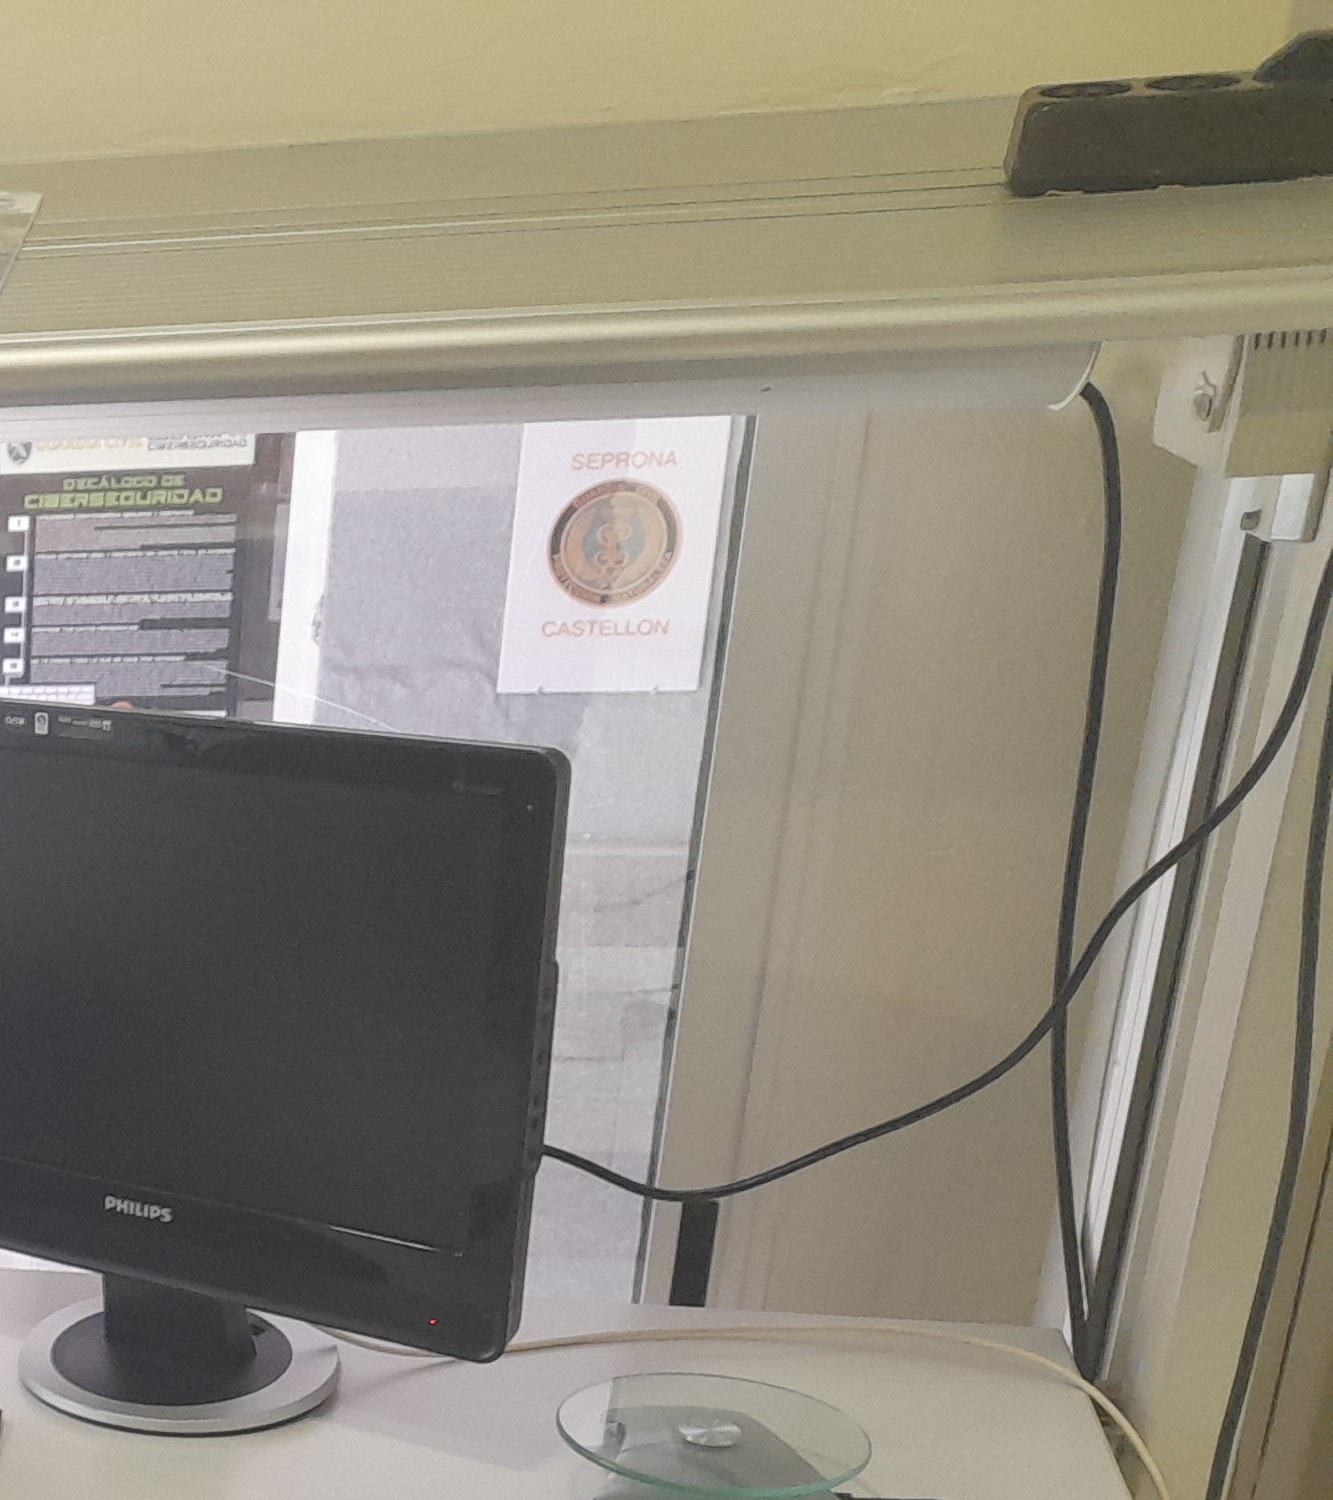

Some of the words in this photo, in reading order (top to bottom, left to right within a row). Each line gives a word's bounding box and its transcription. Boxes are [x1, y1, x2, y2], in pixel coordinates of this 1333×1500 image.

[571, 451, 678, 471] SEPRONA
[160, 472, 186, 487] DE
[23, 488, 225, 510] CIBERSEGURIDAD
[541, 618, 670, 638] CASTELLON
[104, 1195, 173, 1223] PHILIPS
